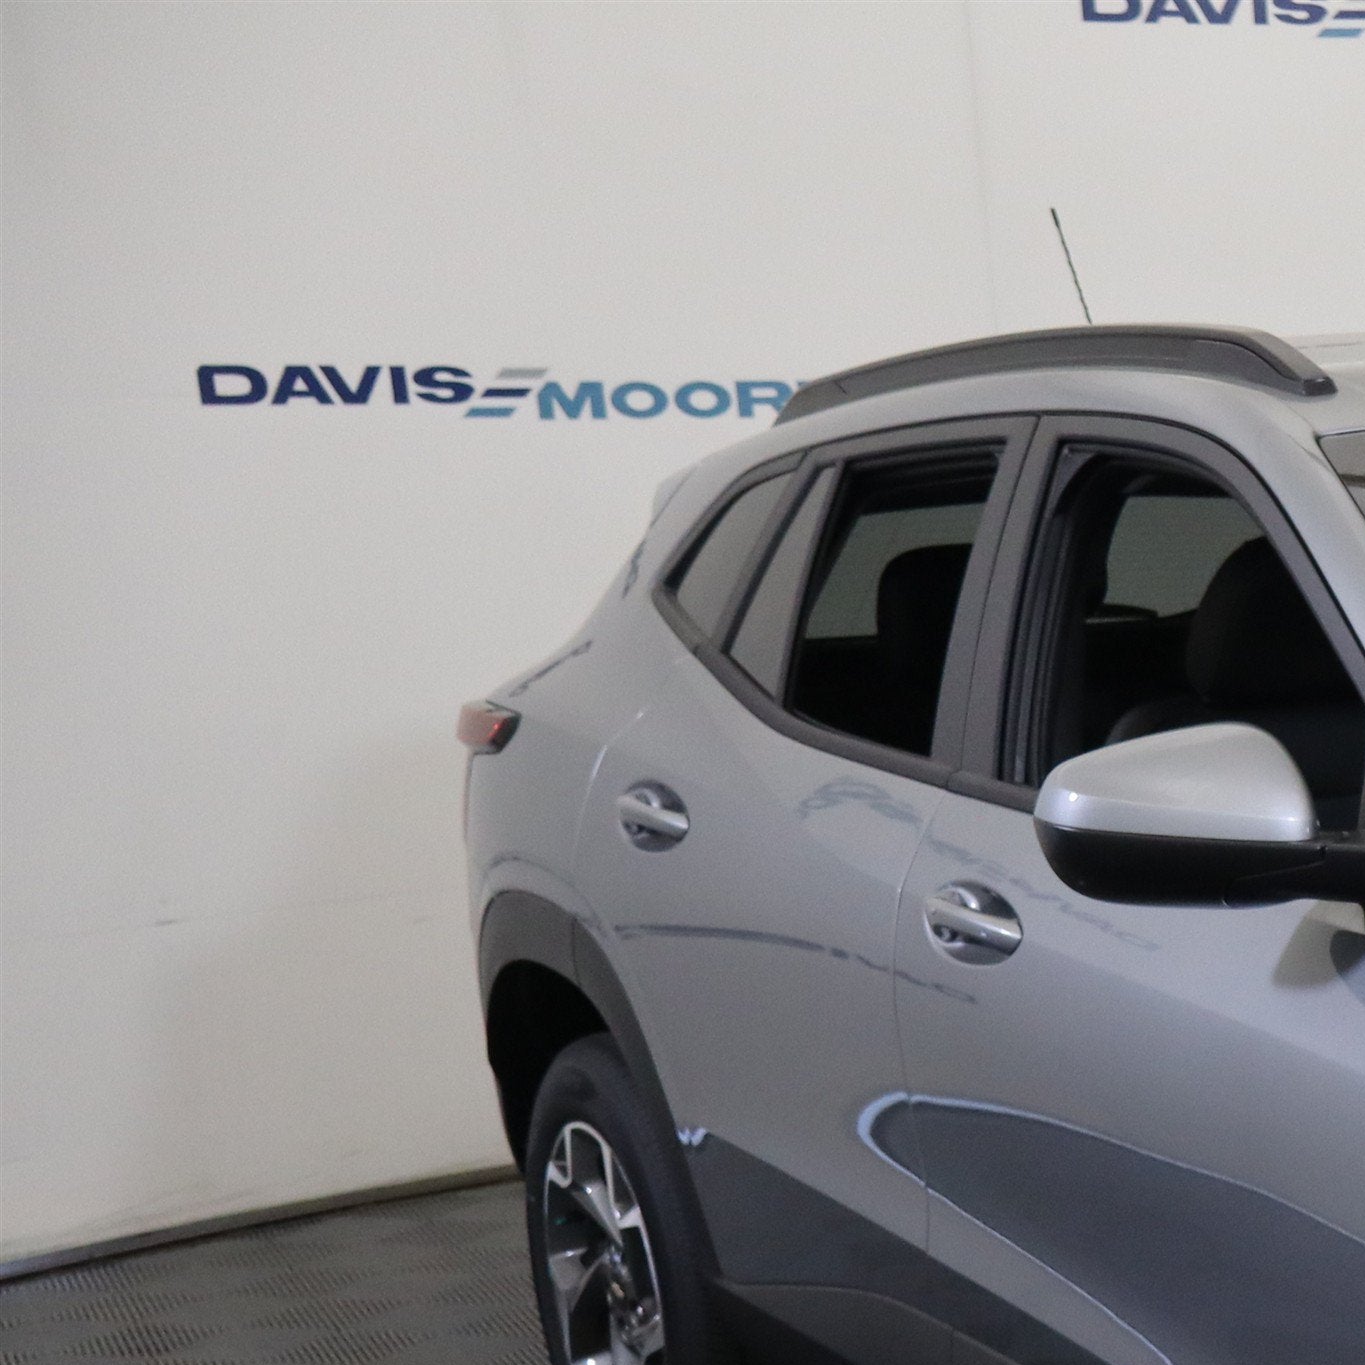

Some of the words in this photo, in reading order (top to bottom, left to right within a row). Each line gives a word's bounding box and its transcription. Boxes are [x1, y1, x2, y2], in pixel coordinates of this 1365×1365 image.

[1082, 0, 1328, 25] DAVIS
[197, 365, 474, 405] DAVIS
[538, 381, 804, 419] MOOR
